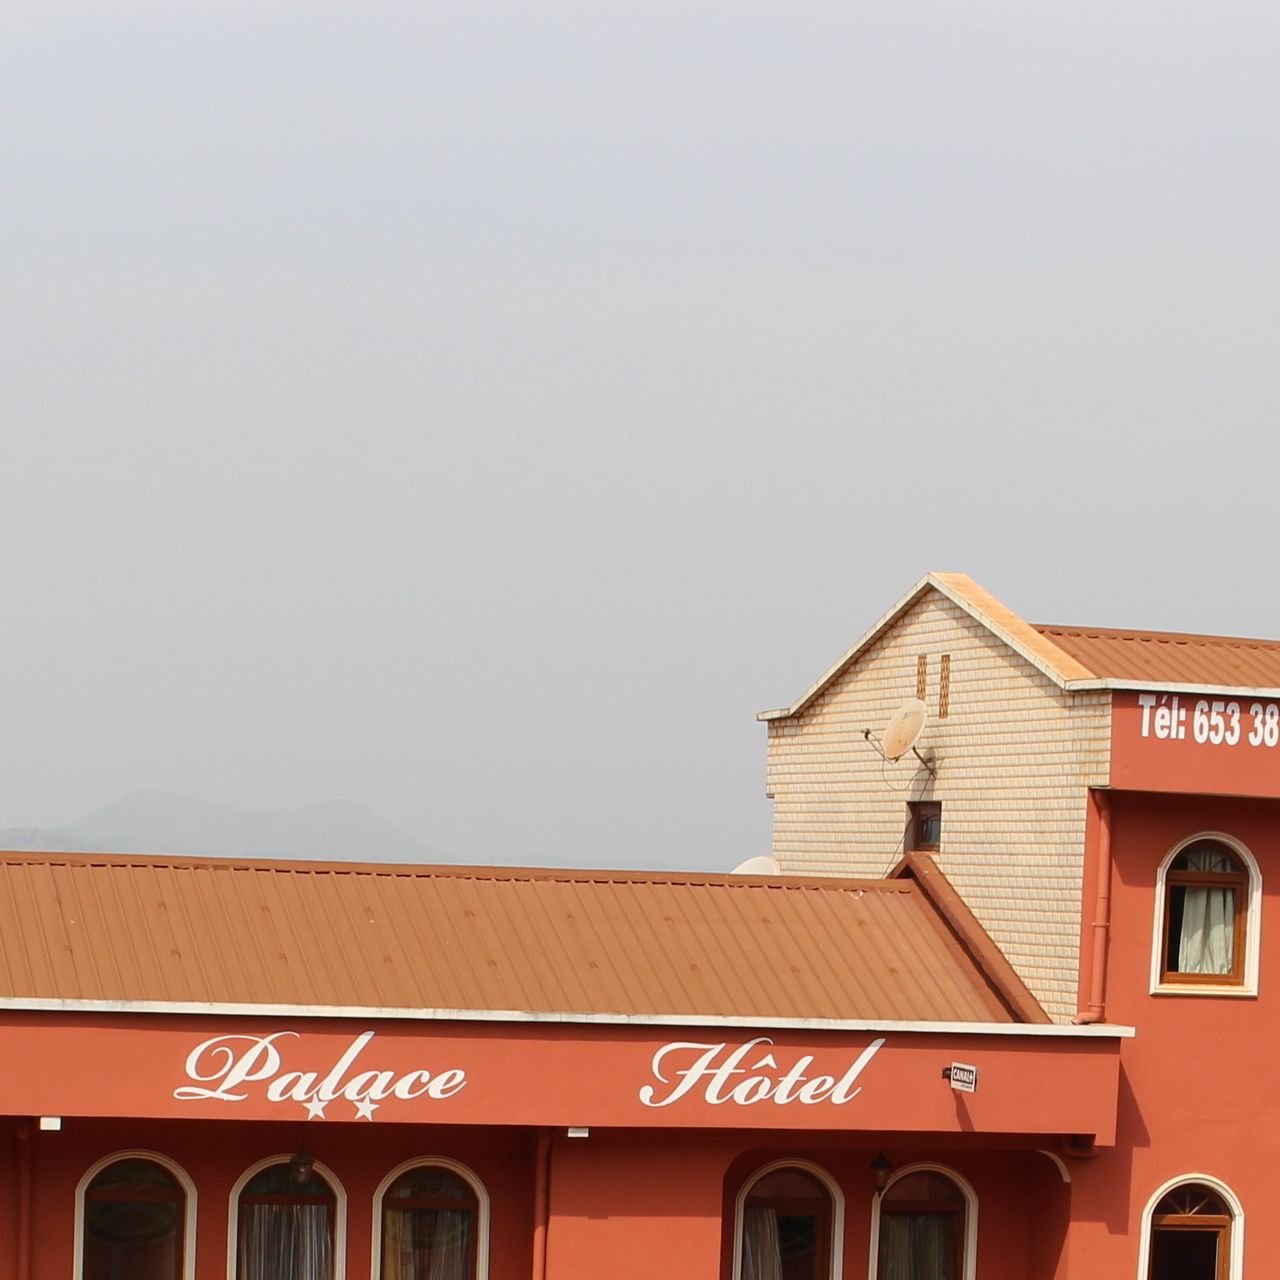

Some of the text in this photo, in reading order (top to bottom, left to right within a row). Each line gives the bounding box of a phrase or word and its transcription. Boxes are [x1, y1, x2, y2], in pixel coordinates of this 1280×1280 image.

[1138, 694, 1187, 740] Tél:
[1193, 700, 1241, 746] 653
[1248, 702, 1280, 748] 38
[173, 1031, 468, 1102] Palace
[639, 1037, 887, 1107] Hôtel
